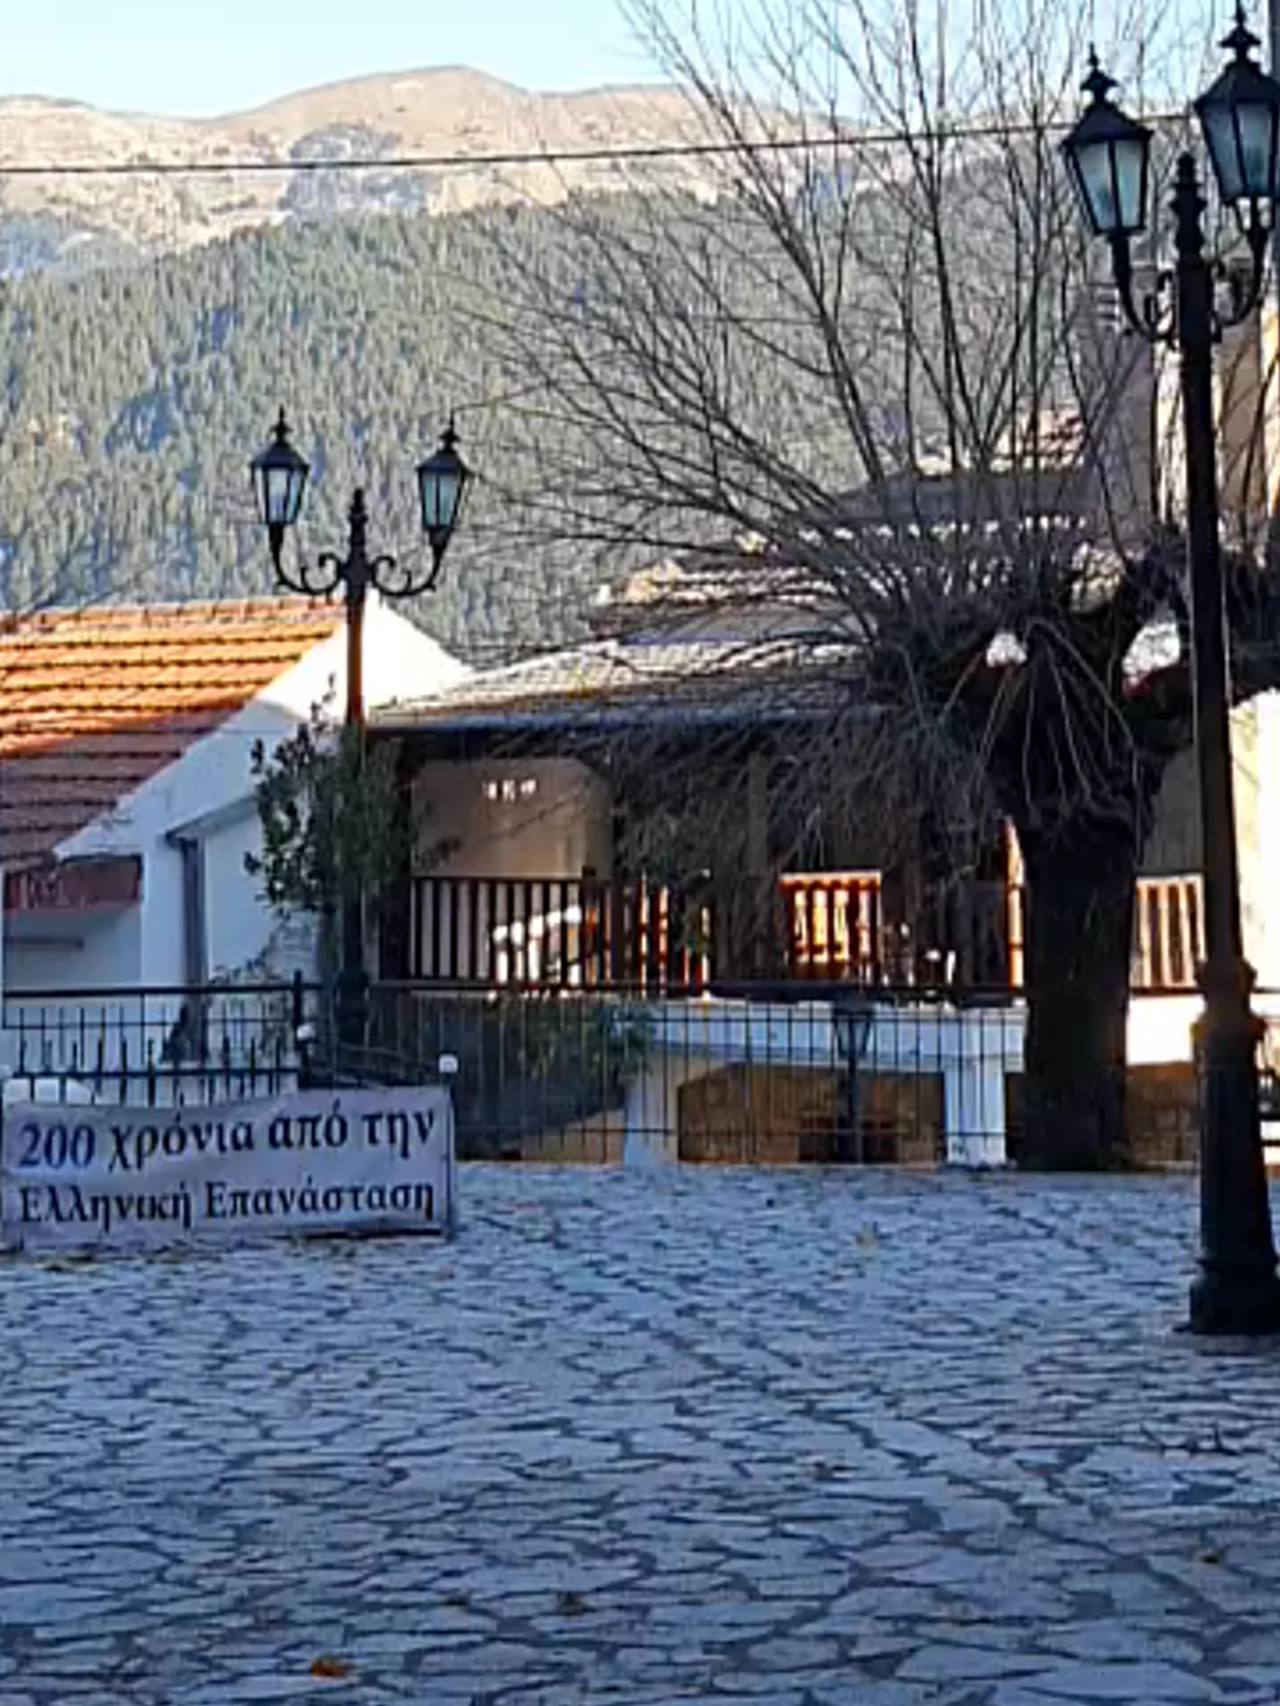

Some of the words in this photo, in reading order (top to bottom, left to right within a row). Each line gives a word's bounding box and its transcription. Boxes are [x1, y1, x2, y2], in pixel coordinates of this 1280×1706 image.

[18, 1120, 96, 1169] 200
[107, 1110, 255, 1174] χρόνια
[267, 1097, 349, 1150] από
[360, 1107, 435, 1159] την
[18, 1180, 190, 1234] Ελληνική
[204, 1174, 434, 1222] Επανάσταση
